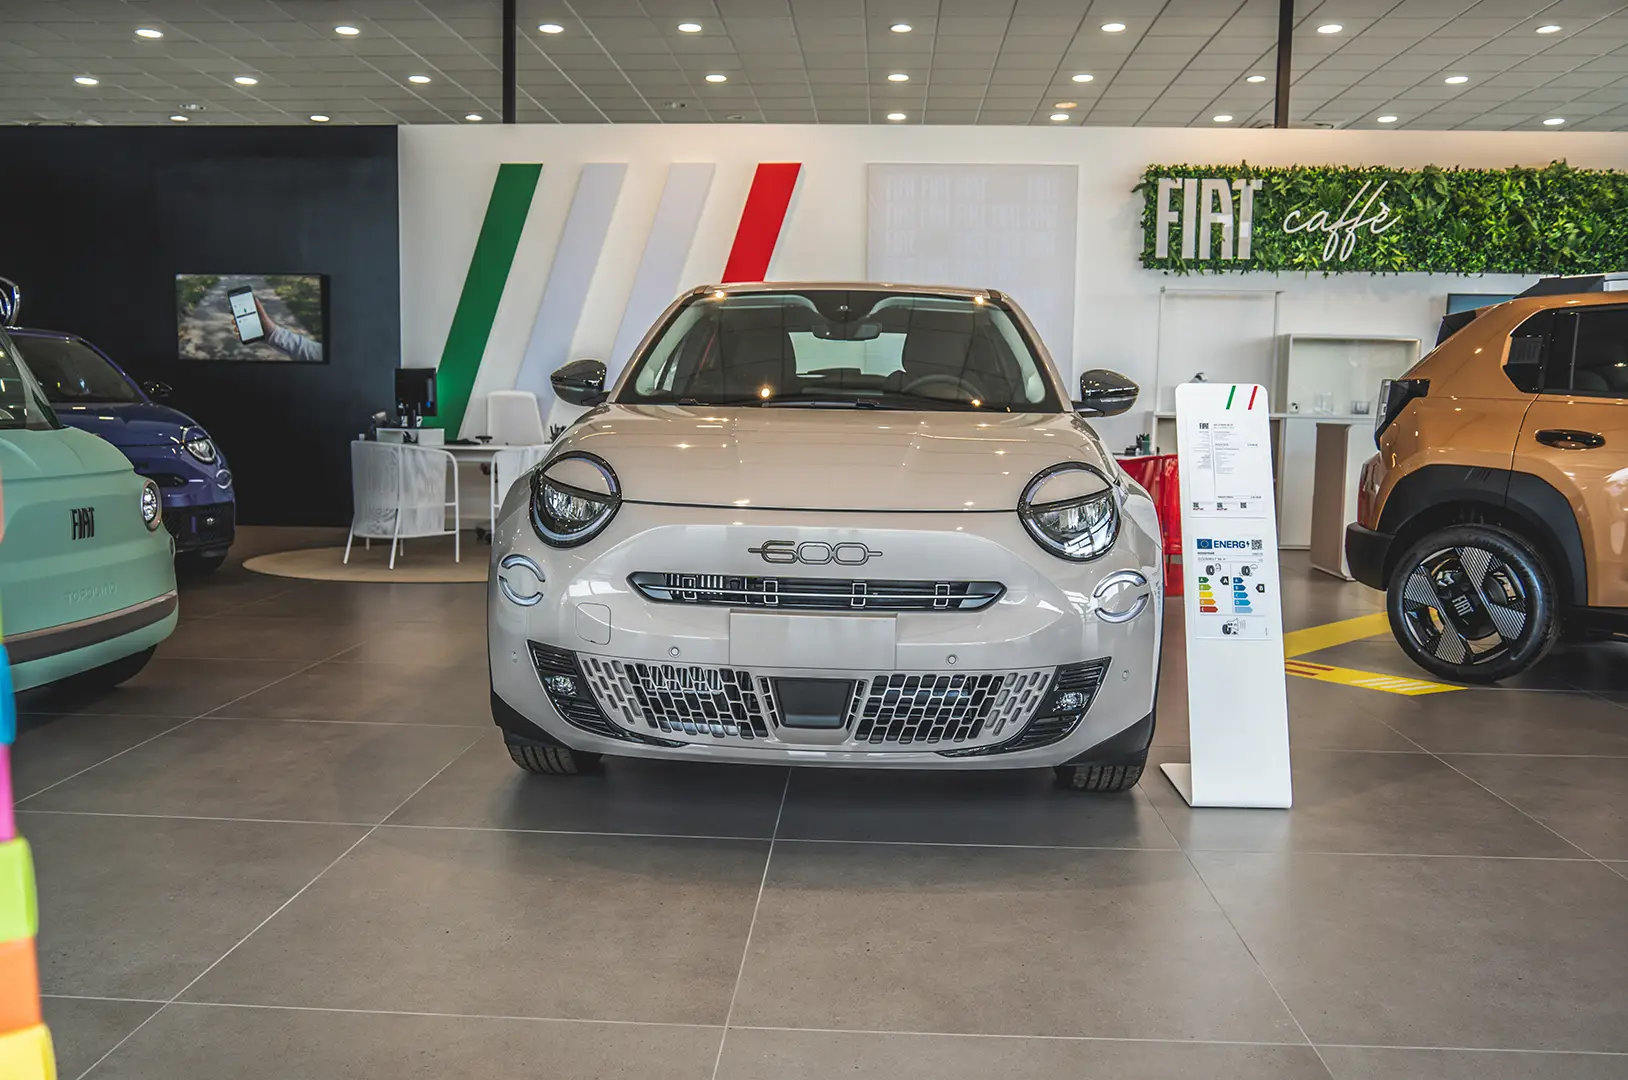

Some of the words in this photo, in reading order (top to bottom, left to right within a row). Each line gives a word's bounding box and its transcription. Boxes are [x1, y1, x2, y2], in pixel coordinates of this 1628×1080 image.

[1155, 178, 1262, 260] FIAT
[71, 507, 95, 540] FIAT
[757, 539, 872, 565] 600
[1213, 540, 1246, 549] ENERG
[63, 581, 119, 606] TOPOLINO
[1452, 594, 1474, 617] FIAT
